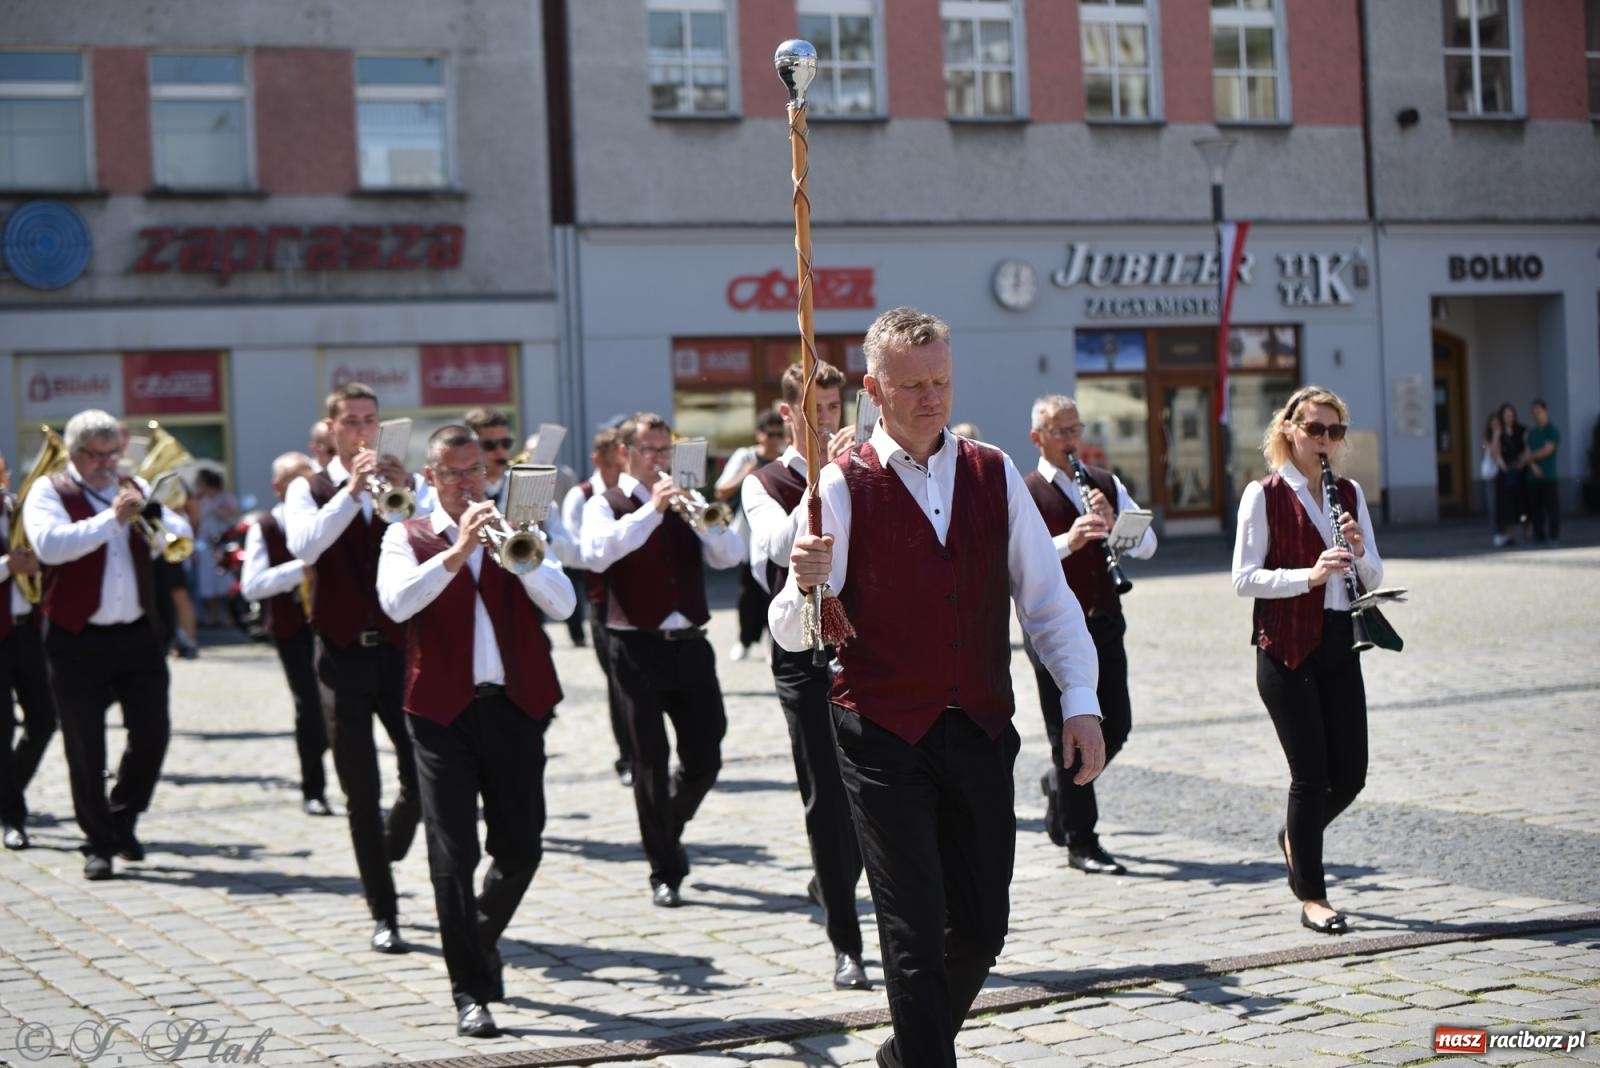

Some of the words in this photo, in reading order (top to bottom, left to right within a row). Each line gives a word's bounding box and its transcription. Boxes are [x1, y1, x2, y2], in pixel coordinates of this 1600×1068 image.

[134, 223, 465, 288] zaprasza
[1052, 241, 1256, 288] JUBILER
[1448, 255, 1544, 281] BOLKO
